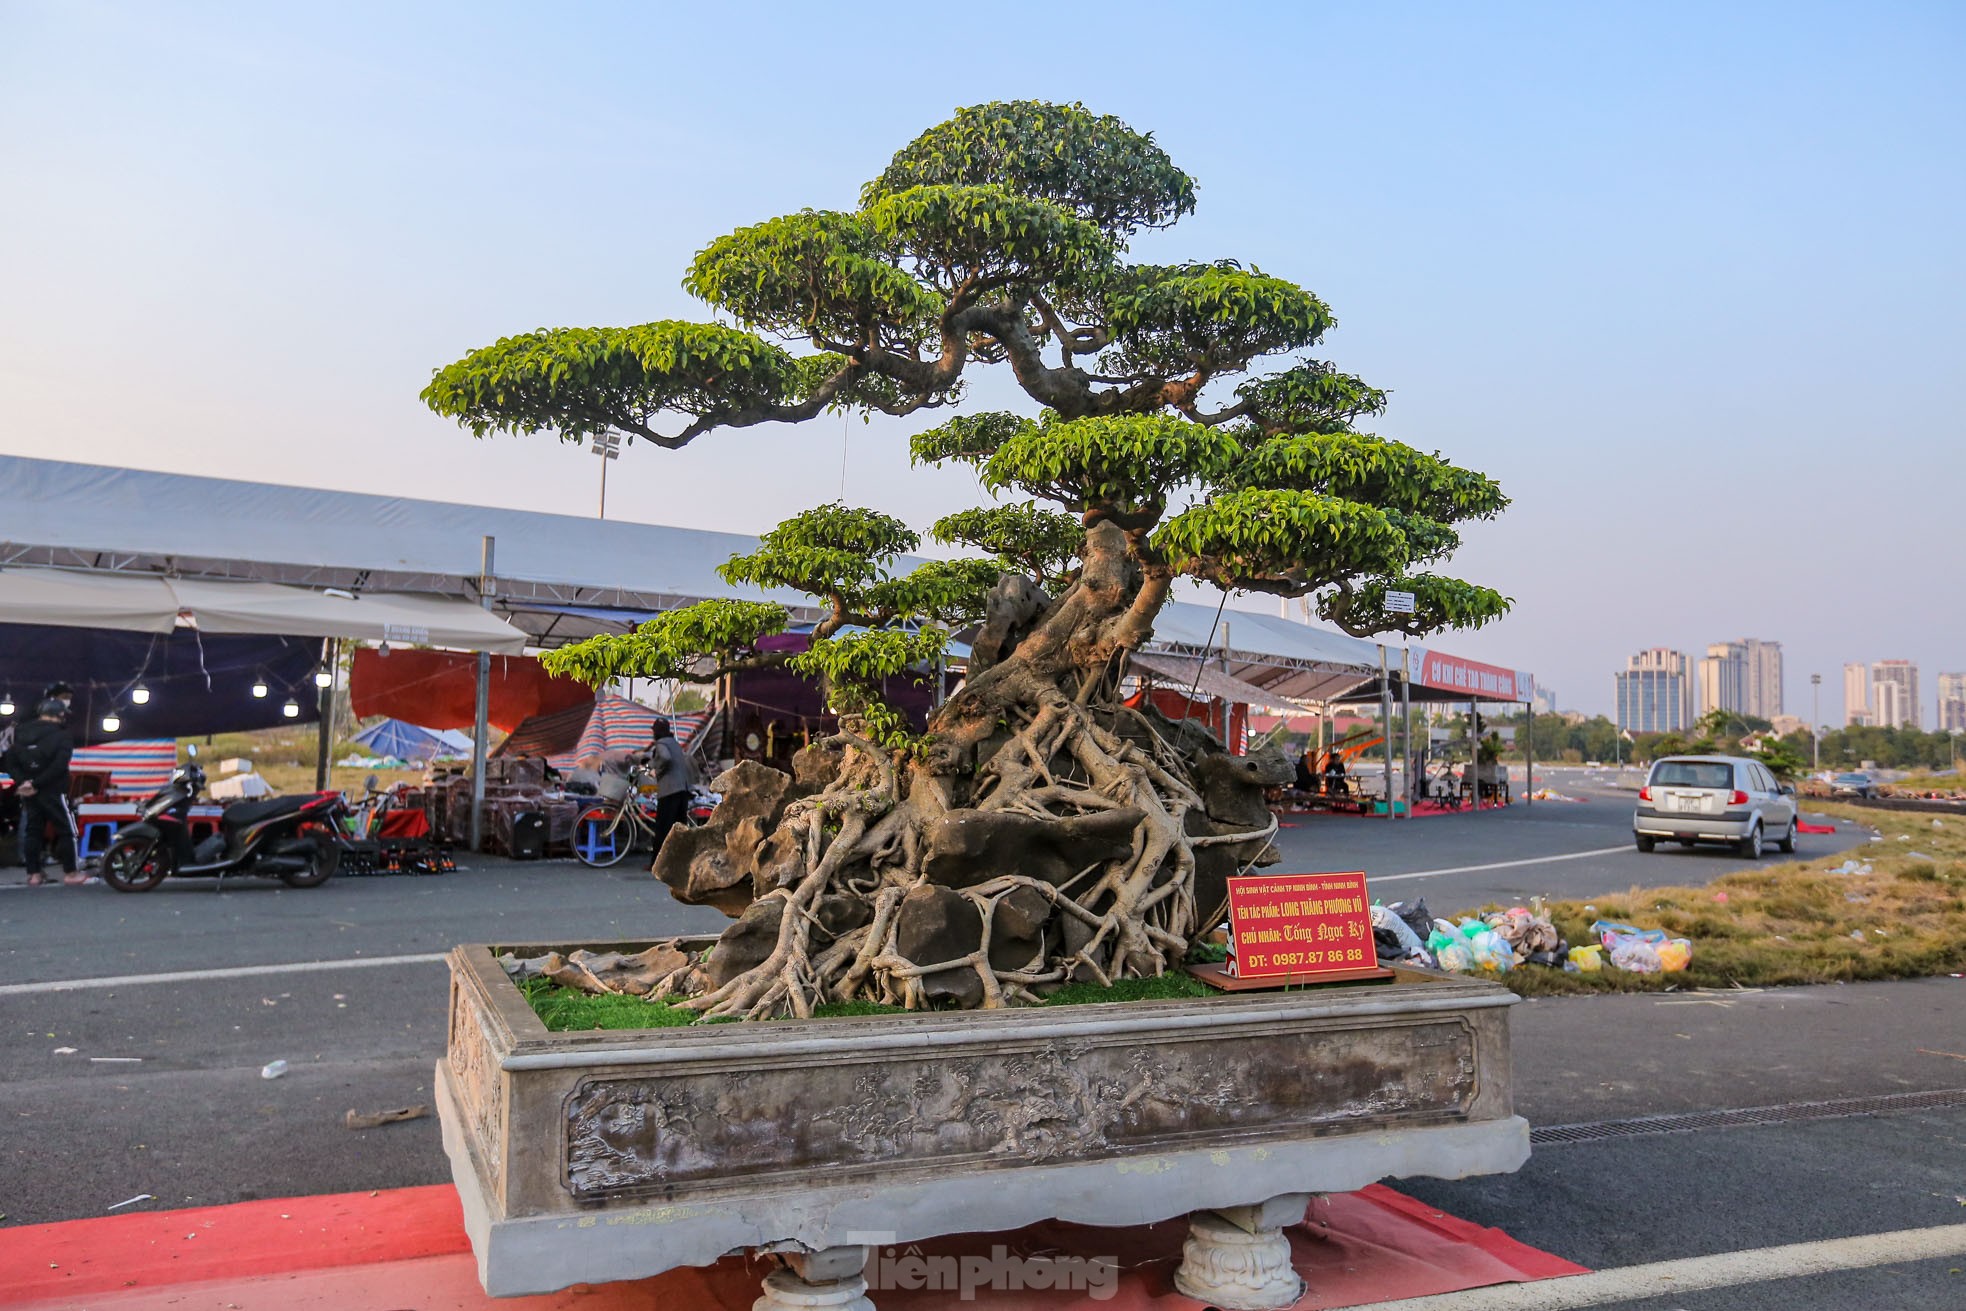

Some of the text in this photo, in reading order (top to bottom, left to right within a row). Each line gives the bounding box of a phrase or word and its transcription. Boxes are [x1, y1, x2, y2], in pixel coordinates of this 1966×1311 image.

[1235, 886, 1246, 896] HỘI
[1246, 886, 1258, 895] SINH
[1259, 884, 1269, 896] VẬT
[1270, 883, 1285, 893] CẢNH
[1285, 884, 1292, 893] TP
[1293, 884, 1305, 892] NINH
[1306, 882, 1318, 891] BÌNH
[1321, 880, 1333, 890] TỈNH
[1334, 881, 1346, 890] NINH
[1346, 880, 1359, 889] BÌNH
[1237, 905, 1249, 919] TÊN
[1249, 904, 1260, 919] TÁC
[1261, 901, 1280, 918] PHẨM:
[1280, 901, 1300, 917] LONG
[1324, 898, 1352, 917] PHƯỢNG
[1352, 895, 1363, 912] VŨ
[1241, 926, 1257, 944] CHỦ
[1258, 928, 1282, 943] NHÂN:
[1283, 922, 1313, 943] Tống
[1317, 923, 1344, 942] Ngọc
[1347, 920, 1365, 940] Ký
[1249, 948, 1363, 968] ĐT: 0987.87 86 88
